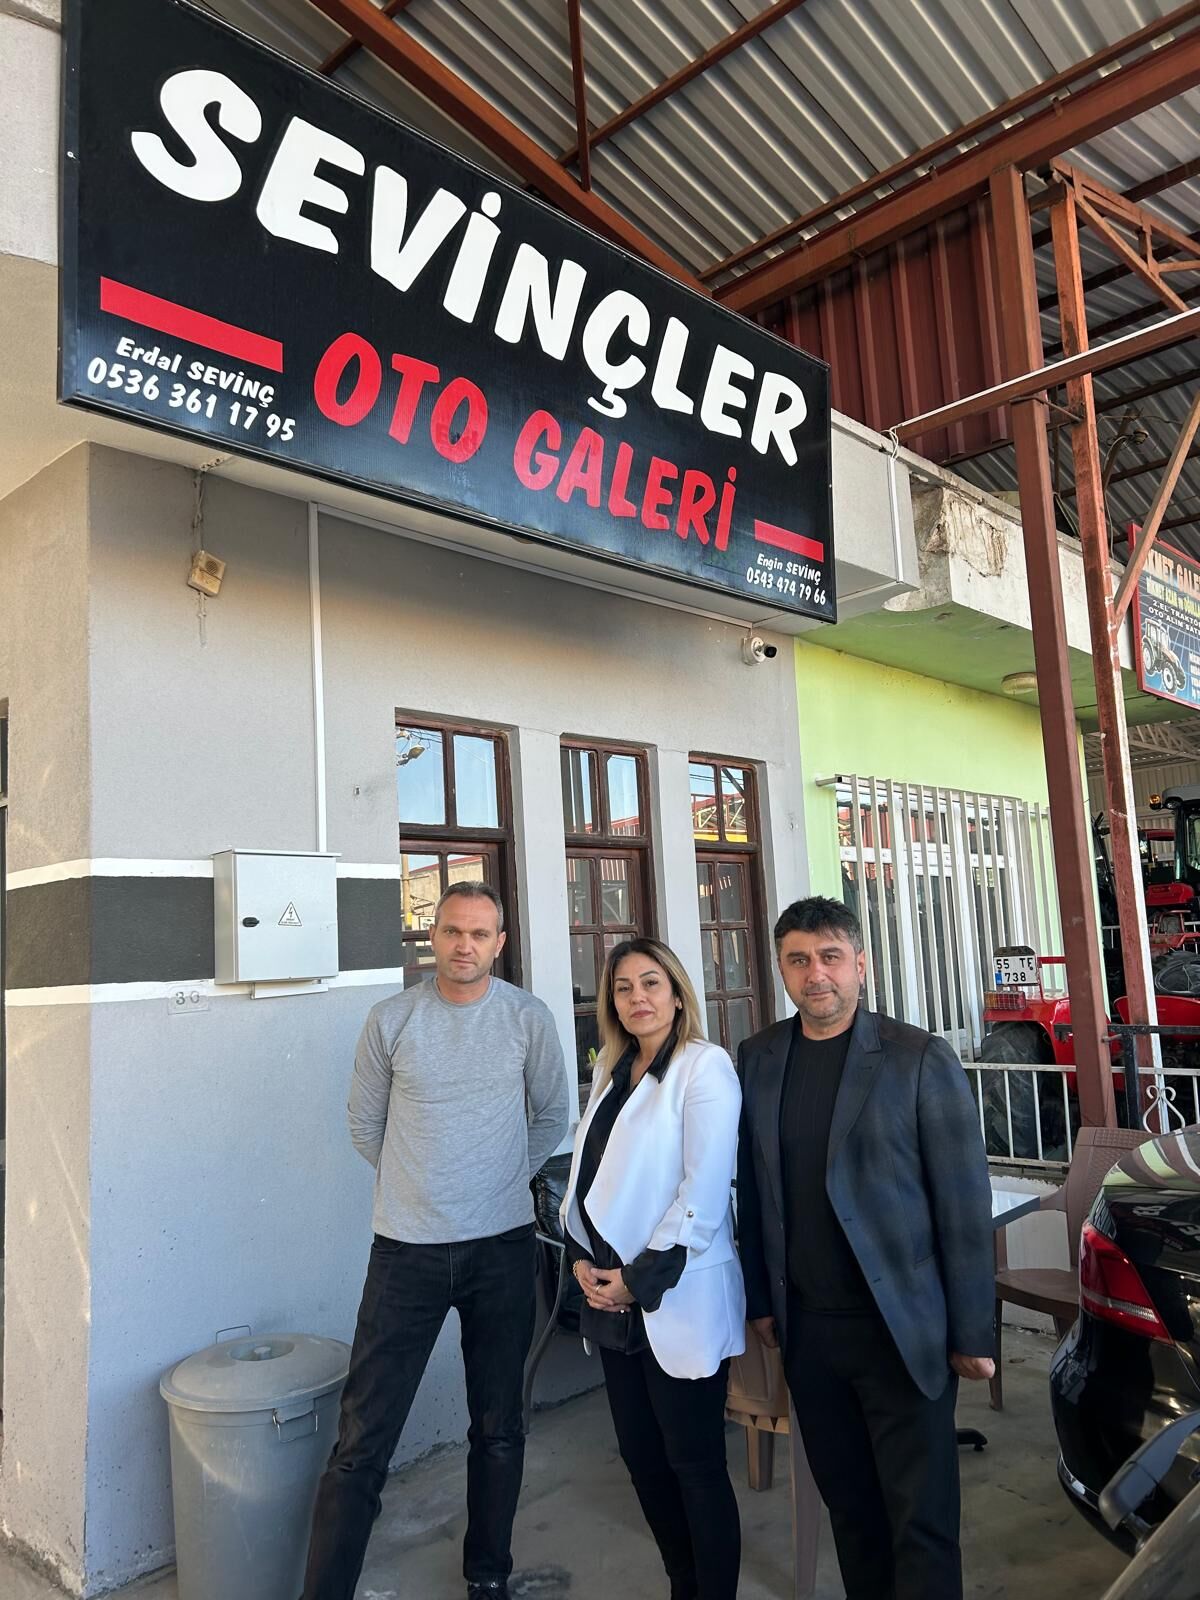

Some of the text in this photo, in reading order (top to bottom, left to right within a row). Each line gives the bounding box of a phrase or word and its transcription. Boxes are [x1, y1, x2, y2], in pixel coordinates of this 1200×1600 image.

[131, 69, 808, 467] SEVİNÇLER
[87, 357, 296, 442] 0536 361 17 95
[115, 336, 275, 408] Erdal SEVİNÇ
[313, 332, 737, 551] OTO GALERİ
[746, 566, 826, 606] 0543 474 79 66
[756, 553, 821, 586] Engin SEVİNÇ
[996, 958, 1010, 970] 55
[1004, 971, 1027, 982] 738
